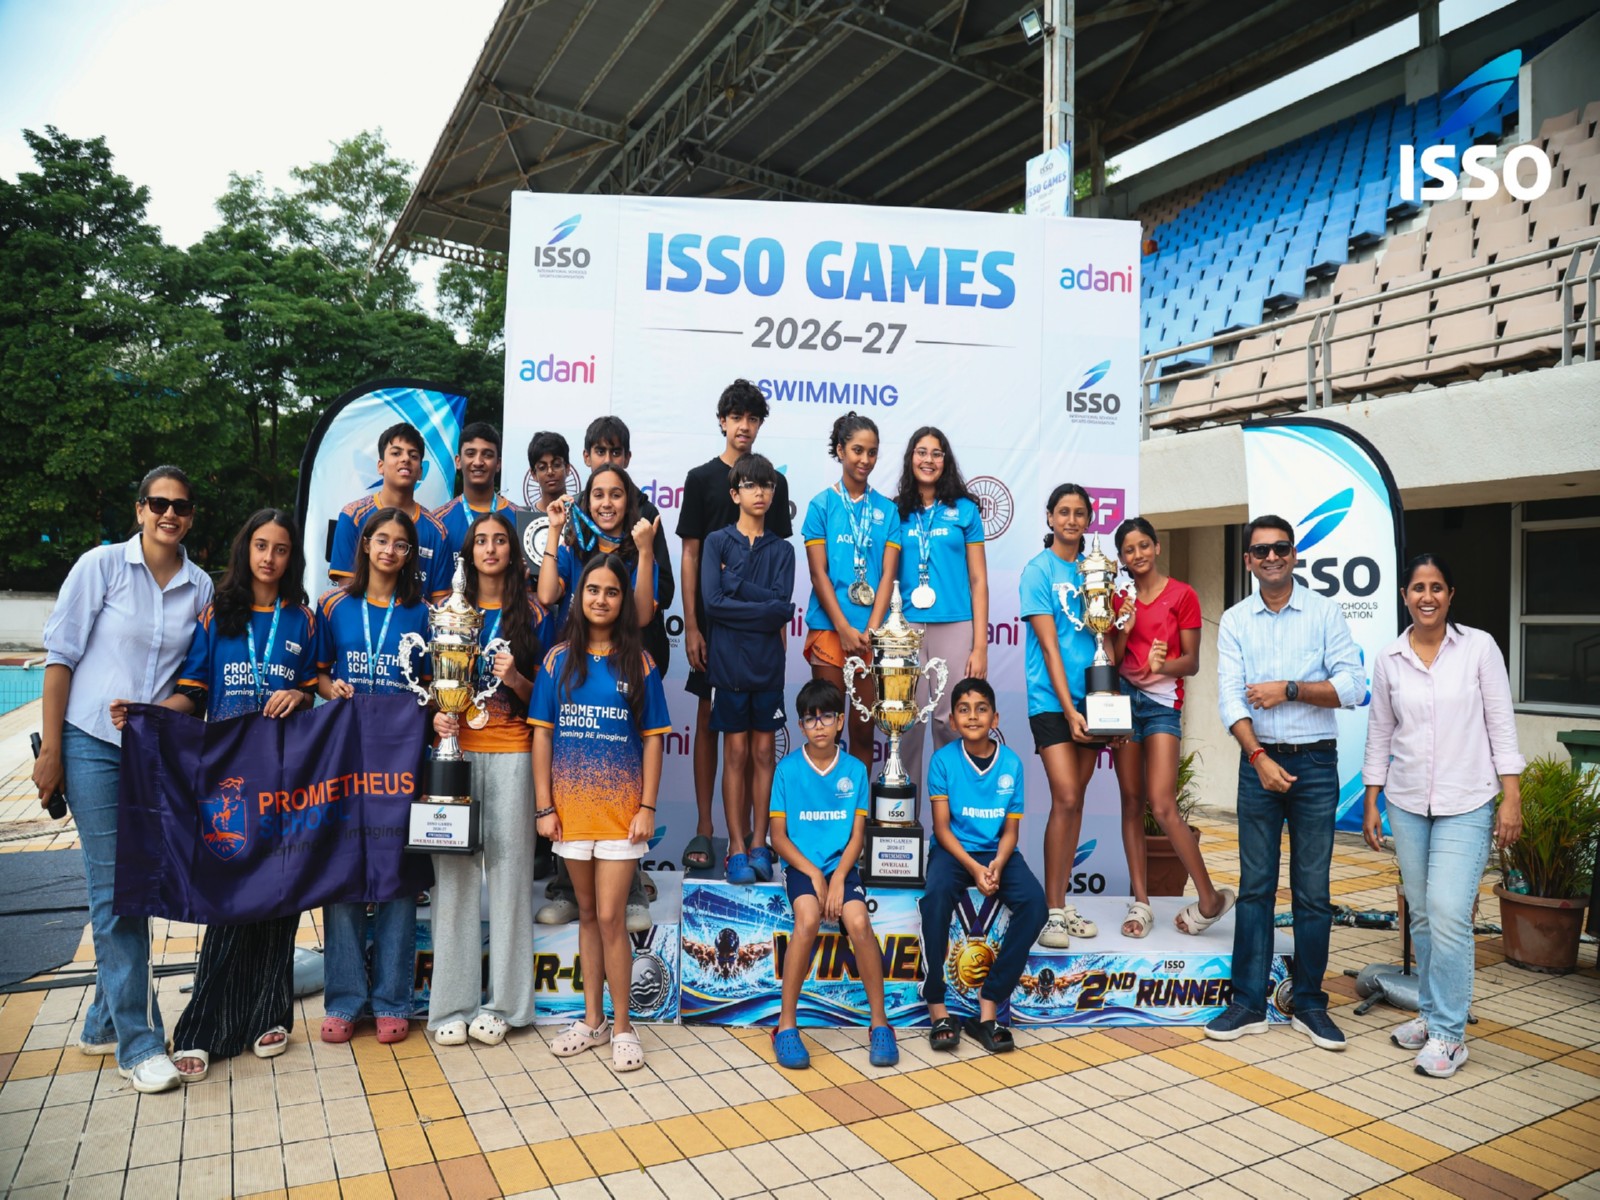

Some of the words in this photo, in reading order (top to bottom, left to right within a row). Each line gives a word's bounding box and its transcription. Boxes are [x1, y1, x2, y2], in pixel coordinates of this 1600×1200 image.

[1043, 171, 1067, 190] GAMES
[534, 246, 591, 269] ISSO
[645, 232, 785, 296] ISSO
[806, 240, 1016, 310] GAMES
[1059, 263, 1133, 294] adani
[519, 353, 596, 384] adani
[757, 379, 899, 407] SWIMMING
[1066, 391, 1121, 415] ISSO
[1338, 602, 1379, 611] CHOOLS
[348, 662, 391, 676] SCHOL
[224, 673, 270, 686] SCHOL
[560, 703, 629, 721] PROMETHEUS
[559, 715, 600, 729] SCHOOL
[585, 730, 595, 739] RE
[258, 771, 415, 815] PROMETHEUS
[258, 801, 352, 839] SCHOOL
[799, 810, 847, 821] AQUATICS
[888, 810, 905, 818] ISSO
[961, 806, 1006, 819] AQUATICS
[1164, 960, 1186, 969] ISSO
